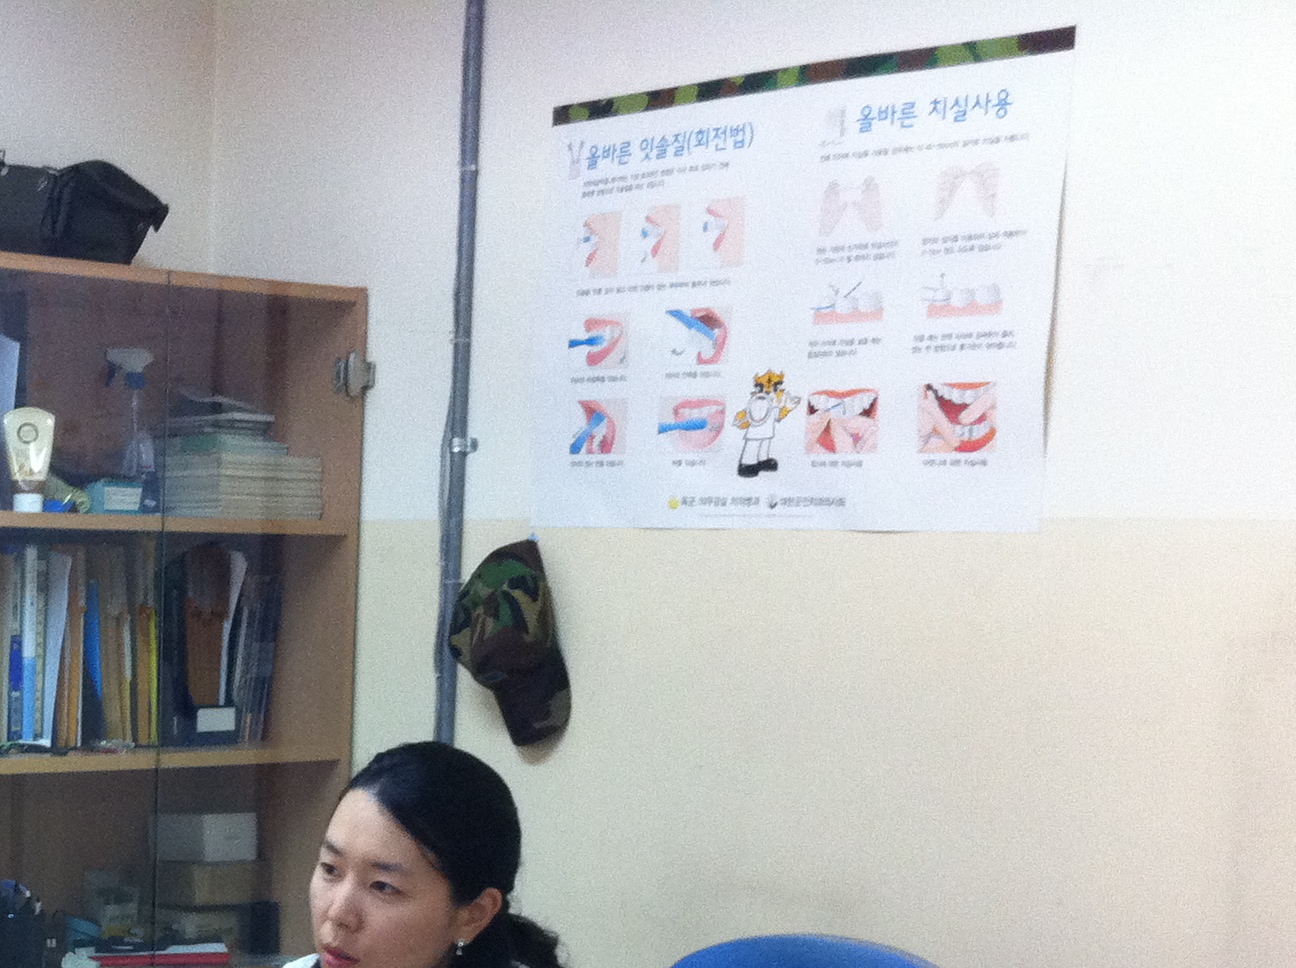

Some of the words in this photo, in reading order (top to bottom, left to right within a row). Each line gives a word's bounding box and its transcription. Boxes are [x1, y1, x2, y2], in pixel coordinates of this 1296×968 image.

[856, 101, 918, 133] 올바른
[928, 88, 1013, 122] 치실사용
[586, 140, 633, 170] 올바른
[639, 121, 755, 162] 잇솔질(회전법)
